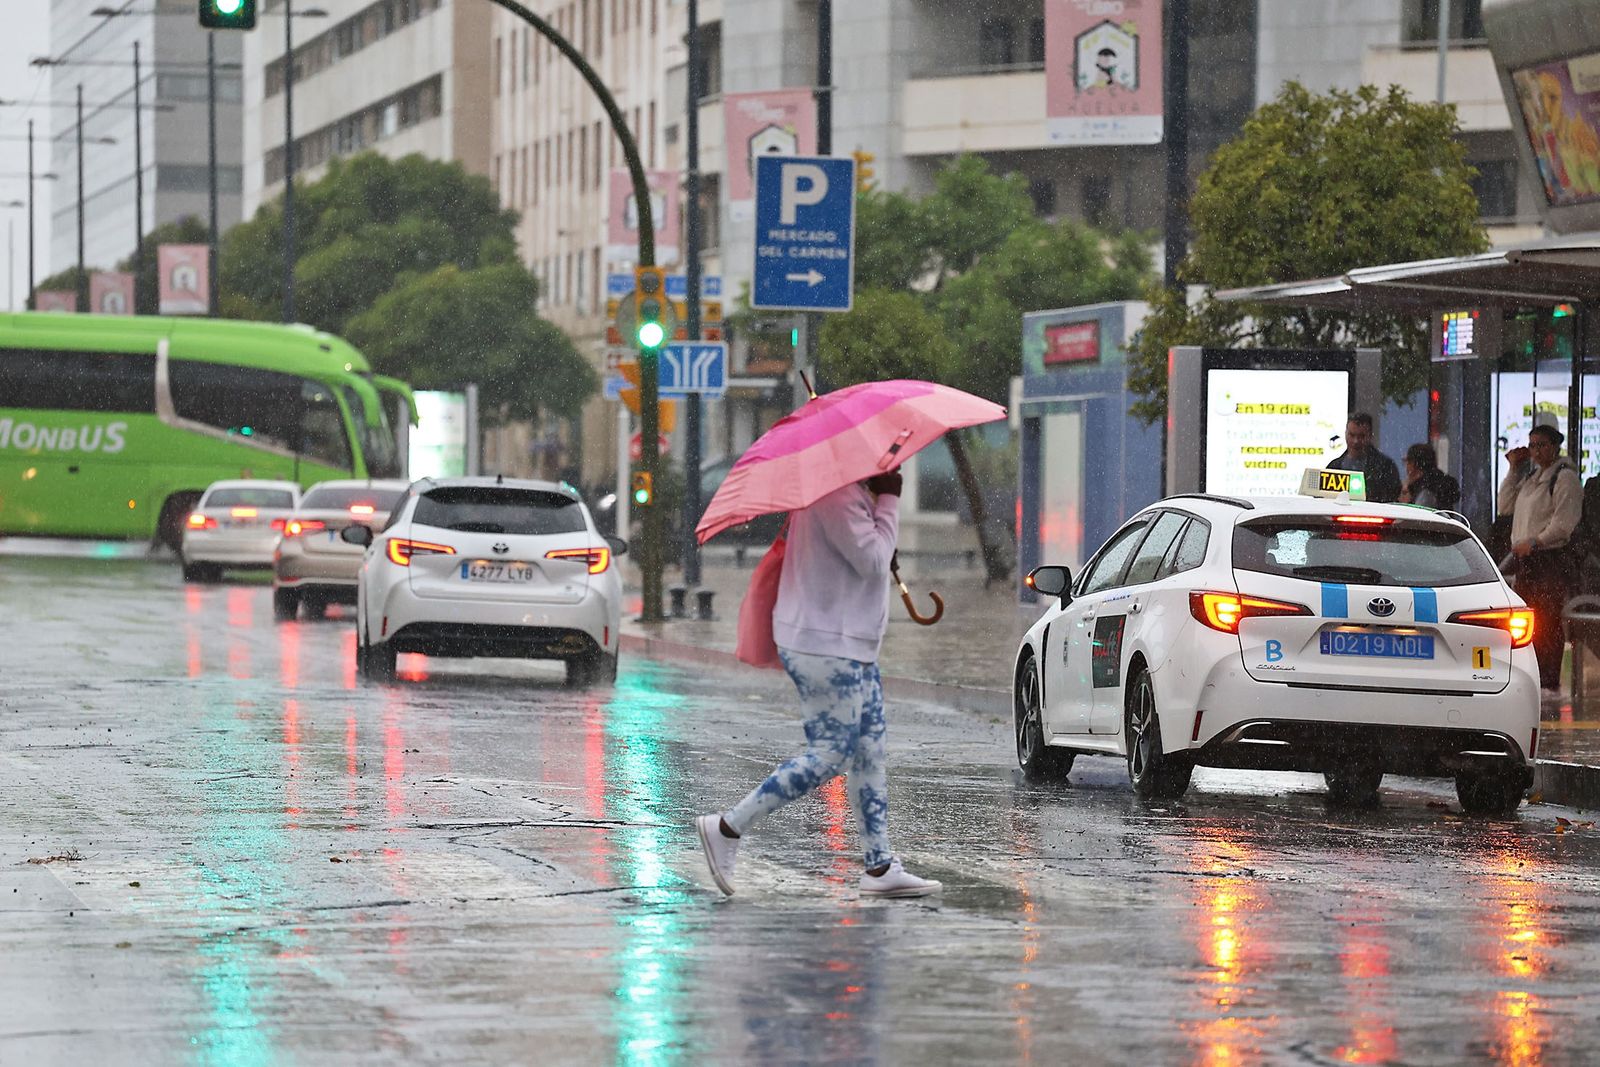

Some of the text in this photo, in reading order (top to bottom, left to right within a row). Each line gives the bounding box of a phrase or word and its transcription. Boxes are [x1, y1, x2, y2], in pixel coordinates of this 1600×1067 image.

[780, 163, 829, 225] P
[768, 229, 837, 242] MERCADO
[758, 245, 848, 259] DEL CARMEN
[1235, 402, 1254, 414] En
[1260, 402, 1275, 414] 19
[1241, 444, 1324, 455] reciclamos
[1244, 459, 1288, 469] vidrio
[1320, 472, 1350, 491] TAXI
[470, 565, 504, 579] 4277
[1266, 639, 1283, 662] B
[1334, 634, 1385, 654] 0219
[1392, 637, 1430, 656] NDL
[1477, 649, 1484, 668] 1
